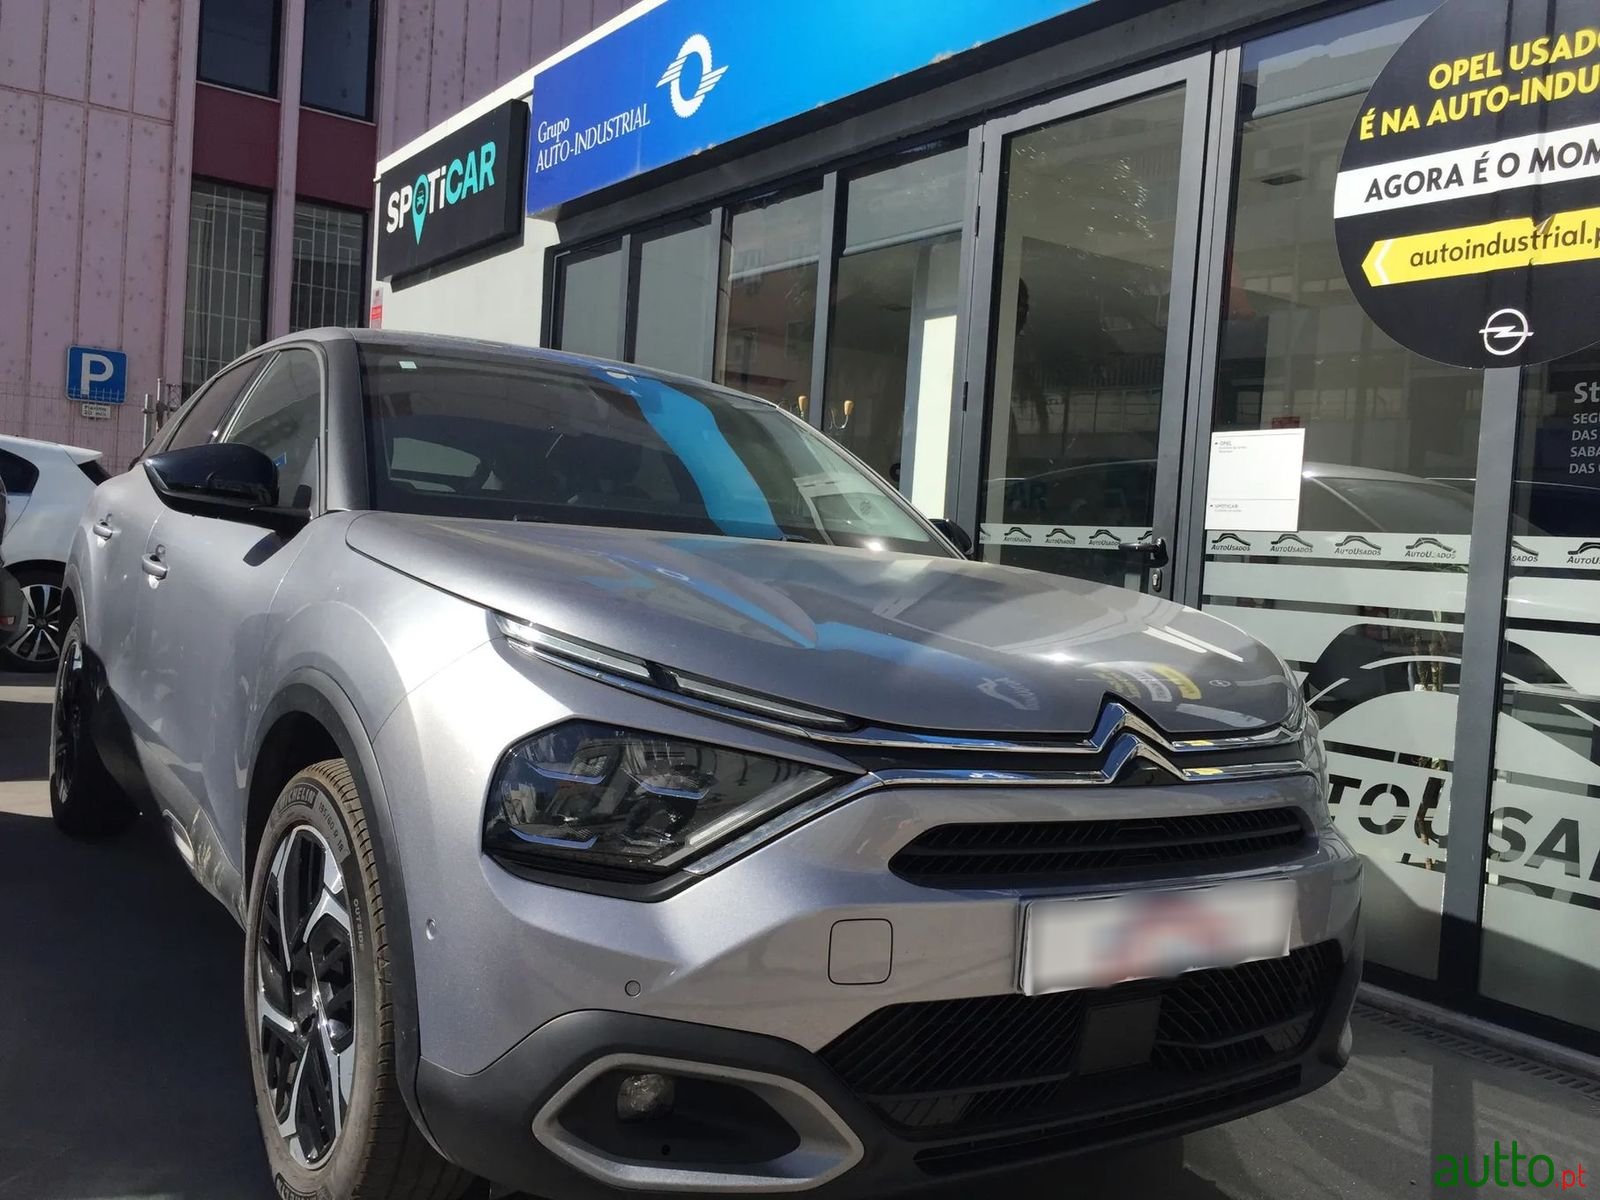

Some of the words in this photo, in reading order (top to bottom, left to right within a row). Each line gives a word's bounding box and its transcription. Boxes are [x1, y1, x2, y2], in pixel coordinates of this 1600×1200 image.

[1428, 51, 1502, 90] OPEL
[1509, 29, 1600, 71] USAD
[1360, 108, 1375, 140] É
[1381, 105, 1420, 135] NA
[1426, 64, 1600, 126] AUTO-INDU
[536, 103, 651, 173] AUTO-INDUSTRIAL
[538, 118, 570, 143] Grupo
[1364, 163, 1464, 203] AGORA
[1473, 151, 1490, 184] É
[1497, 152, 1520, 178] O
[81, 352, 114, 395] P
[1571, 429, 1598, 441] DAS
[1573, 412, 1600, 424] SEG
[1568, 463, 1595, 474] DAS
